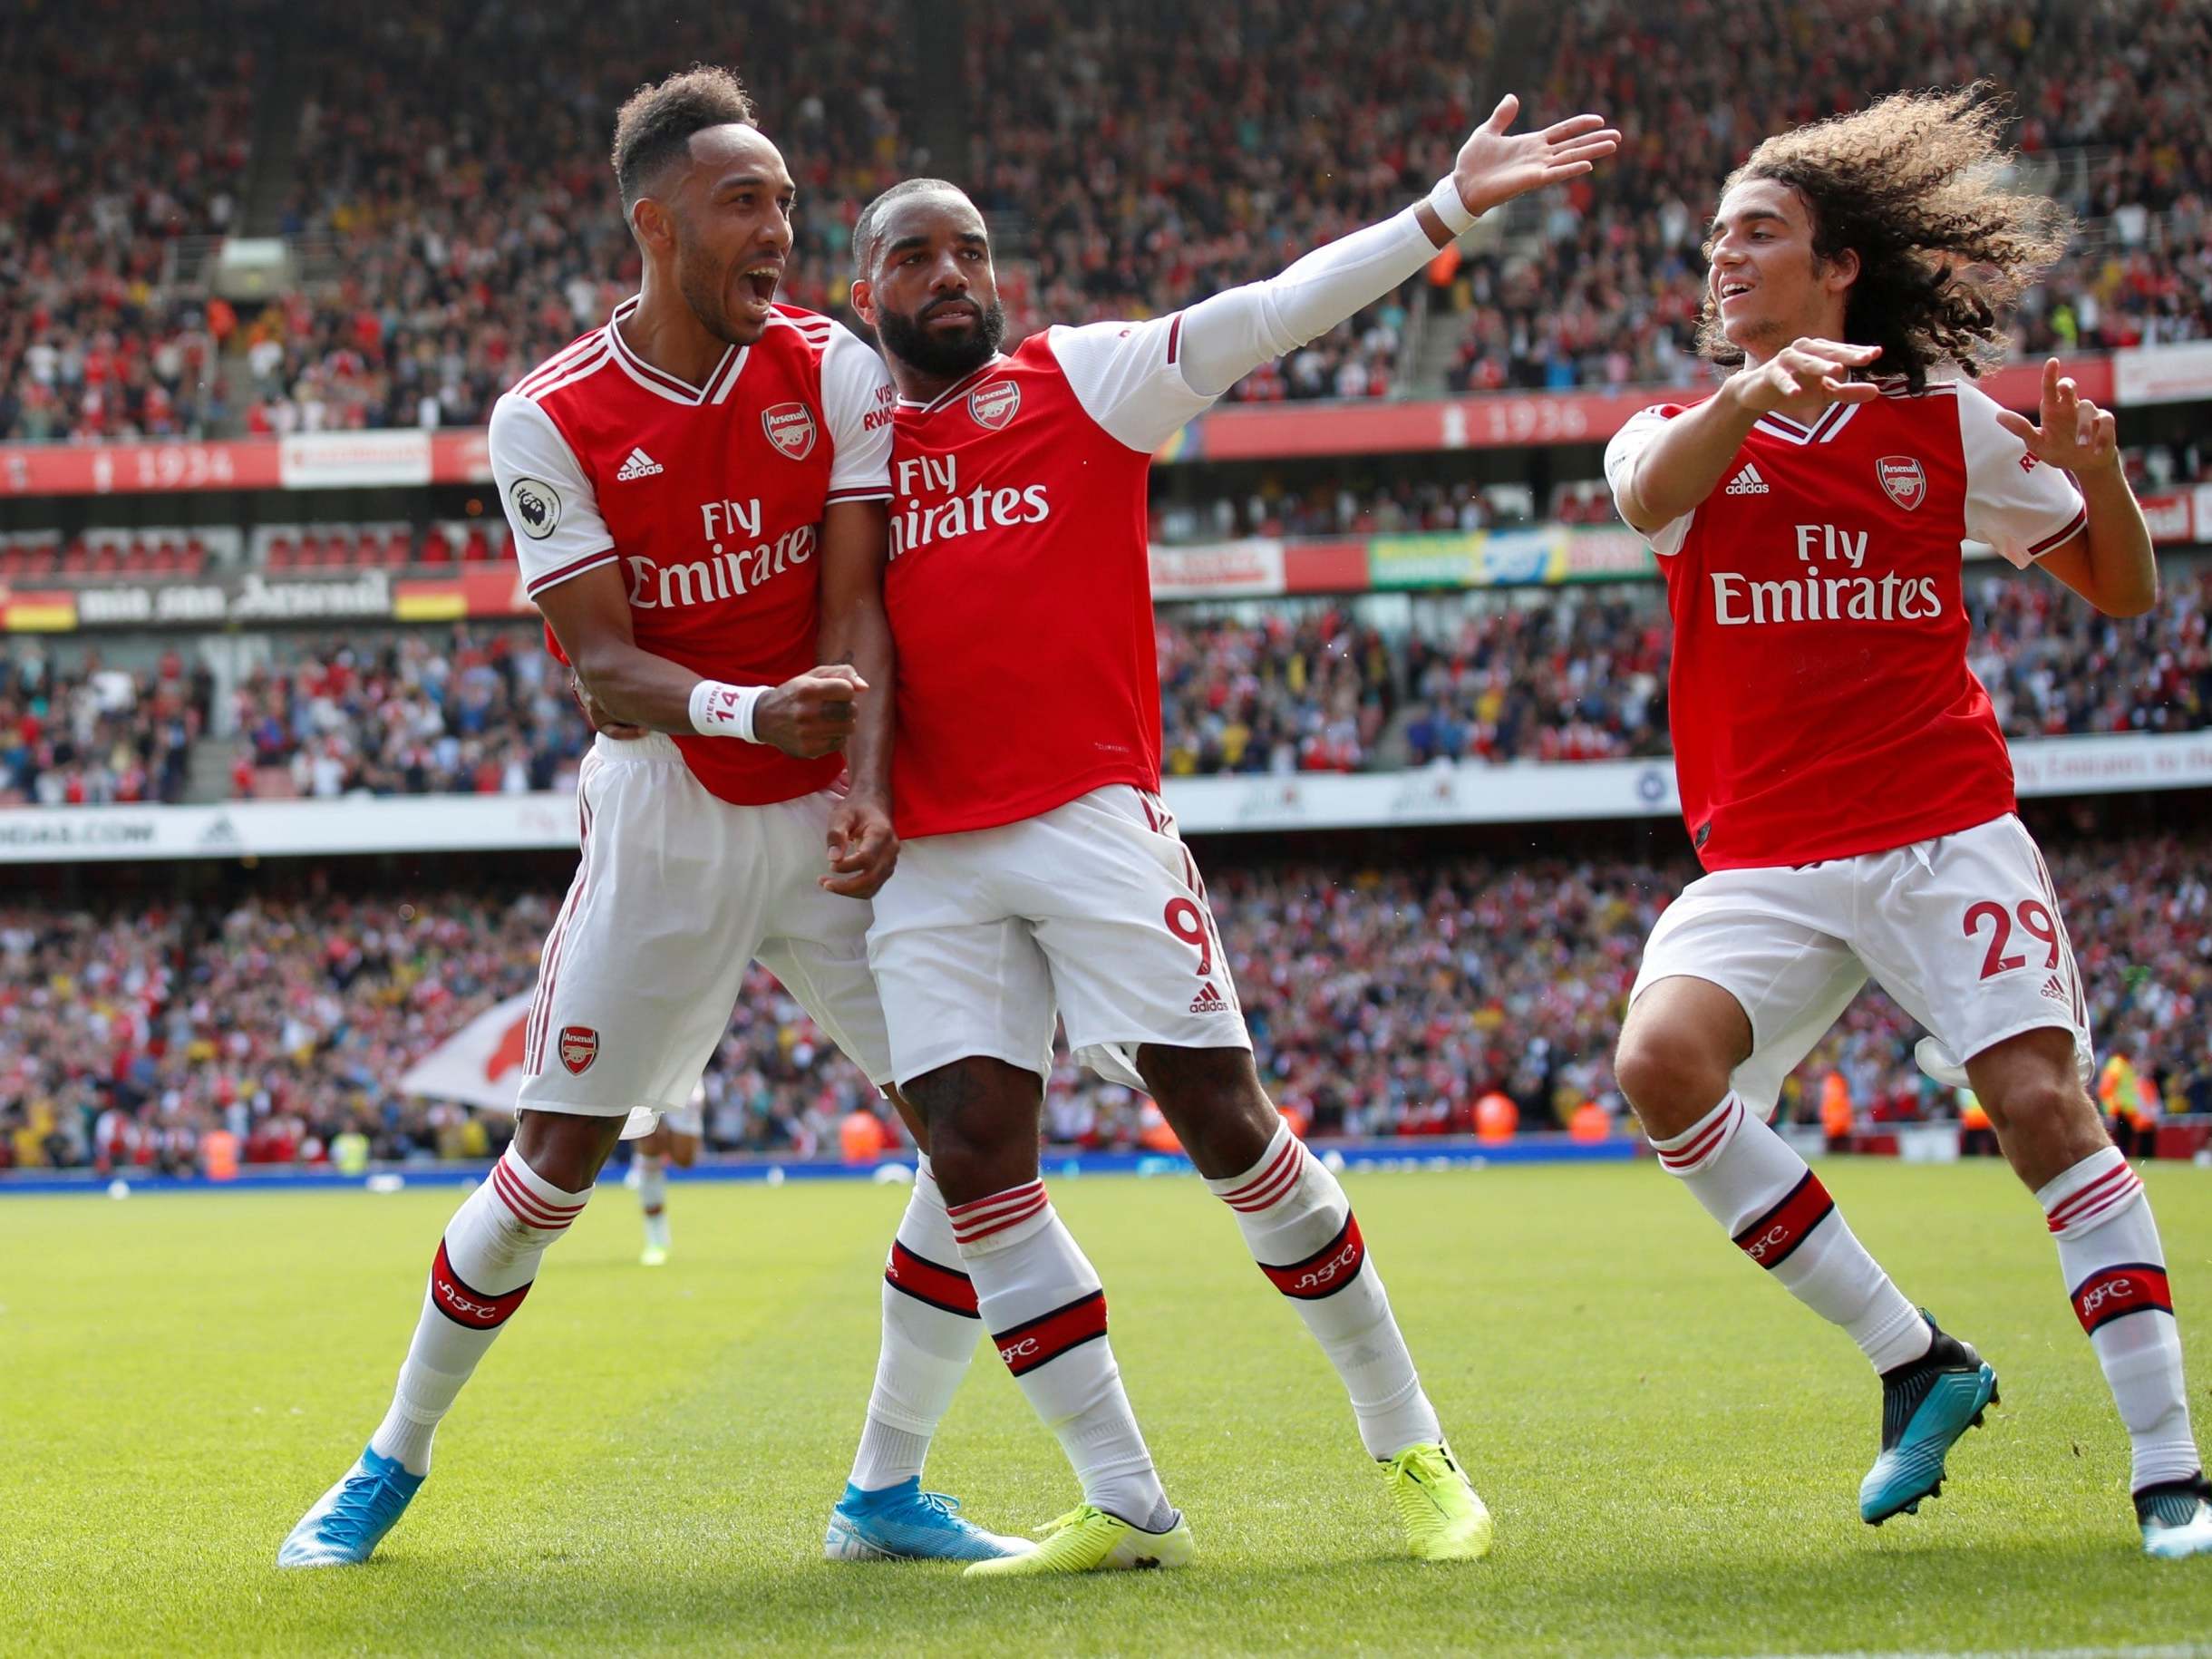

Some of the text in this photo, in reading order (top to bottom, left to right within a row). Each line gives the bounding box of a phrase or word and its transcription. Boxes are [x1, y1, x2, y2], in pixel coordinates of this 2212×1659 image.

[975, 386, 1012, 404] Arsenal
[769, 409, 806, 426] Arsenal
[616, 463, 665, 482] adidas
[897, 453, 957, 496] Fly
[1883, 463, 1918, 474] Arsenal
[1725, 481, 1770, 495] adidas
[700, 498, 762, 541] Fly
[888, 481, 1050, 562] mirates
[1794, 524, 1868, 568] Fly
[1710, 566, 1942, 625] Emirates
[715, 691, 741, 723] 14
[1164, 897, 1212, 976] 9
[1963, 898, 2060, 982] 29
[1189, 1000, 1228, 1014] adidas
[564, 1033, 595, 1044] Arsenal
[1000, 1337, 1040, 1364] FC
